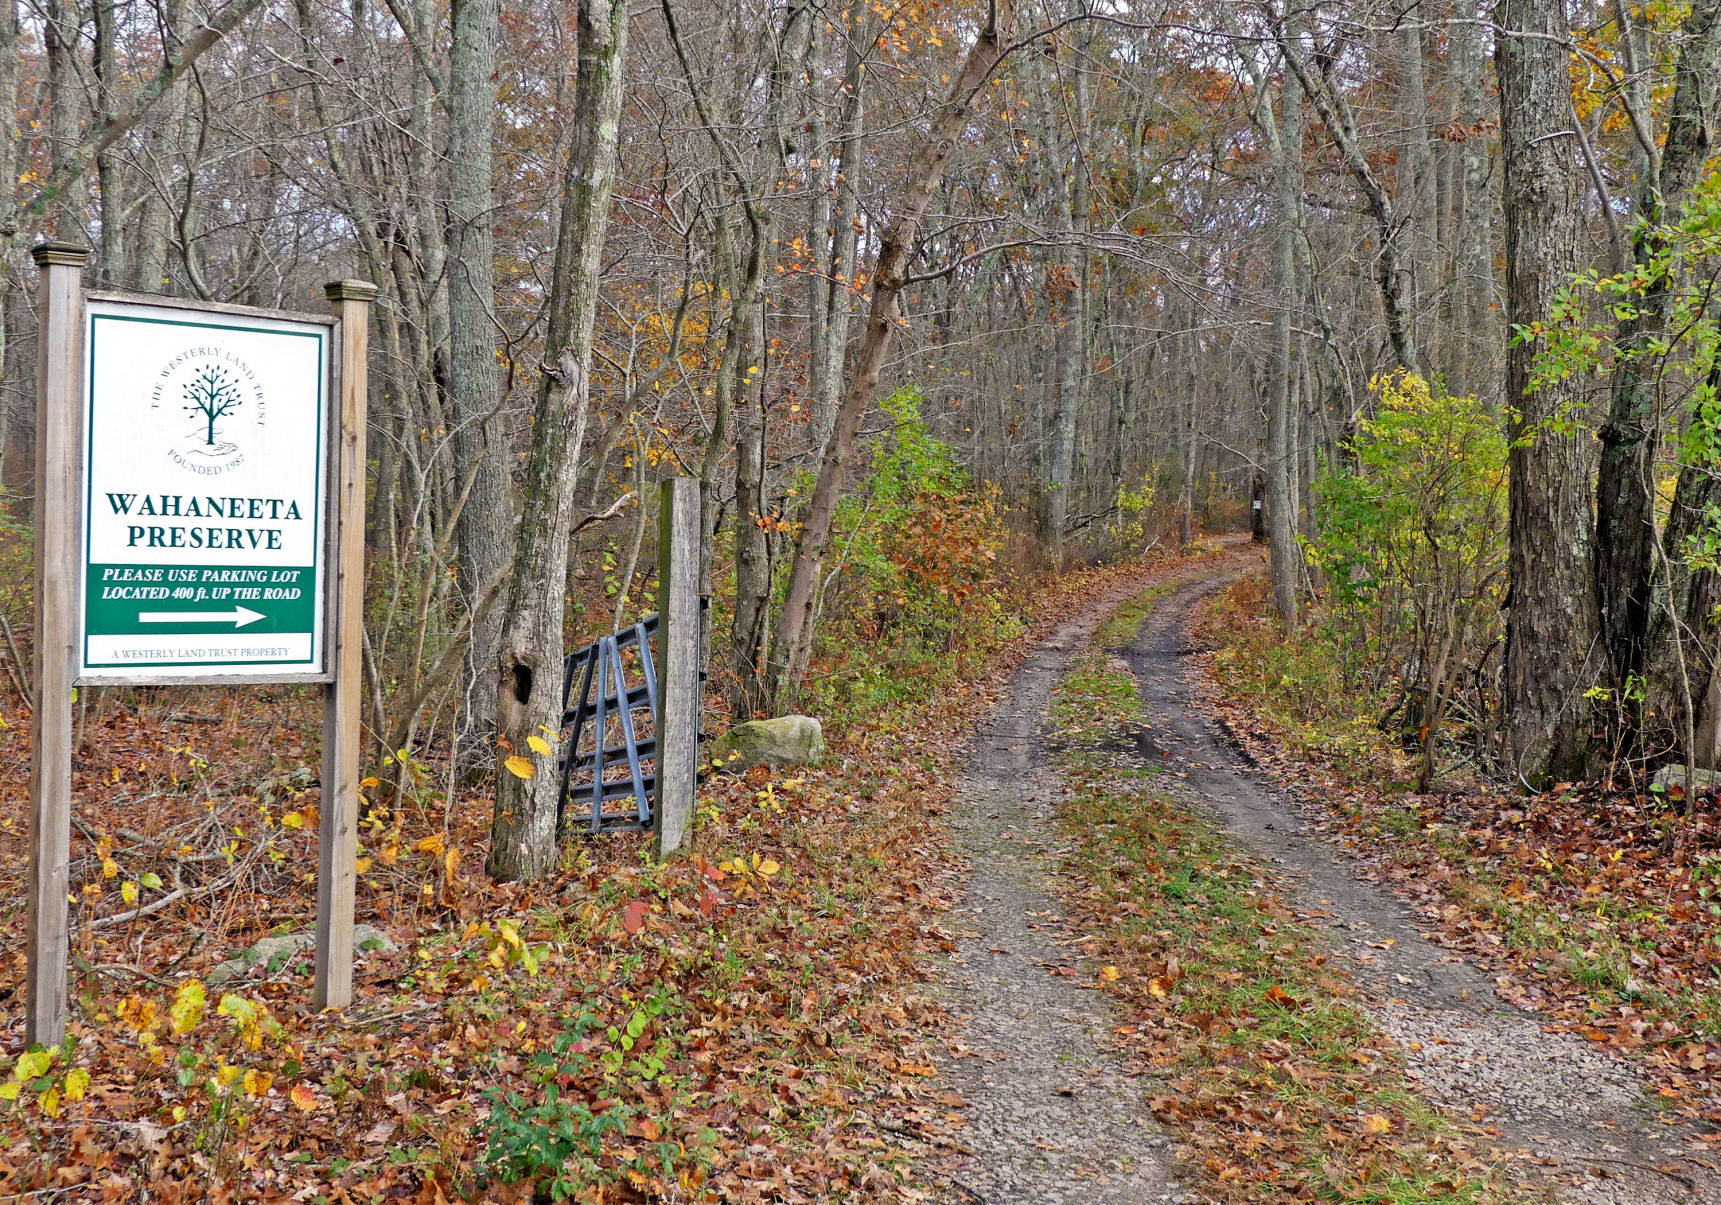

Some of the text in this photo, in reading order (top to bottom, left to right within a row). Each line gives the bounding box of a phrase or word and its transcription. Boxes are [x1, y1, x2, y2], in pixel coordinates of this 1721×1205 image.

[151, 346, 266, 428] THE WESTERLY LAND TRUST
[167, 449, 245, 475] FOUNDED 1987
[105, 493, 303, 520] WAHANEETA
[126, 526, 283, 550] PRESERVE
[102, 568, 301, 583] PLEASE USE PARKING LOT
[102, 586, 301, 602] LOCATED 400 ft. UP THE ROAD
[112, 647, 291, 659] A WESTERLY LAND TRUST PROPERTY
